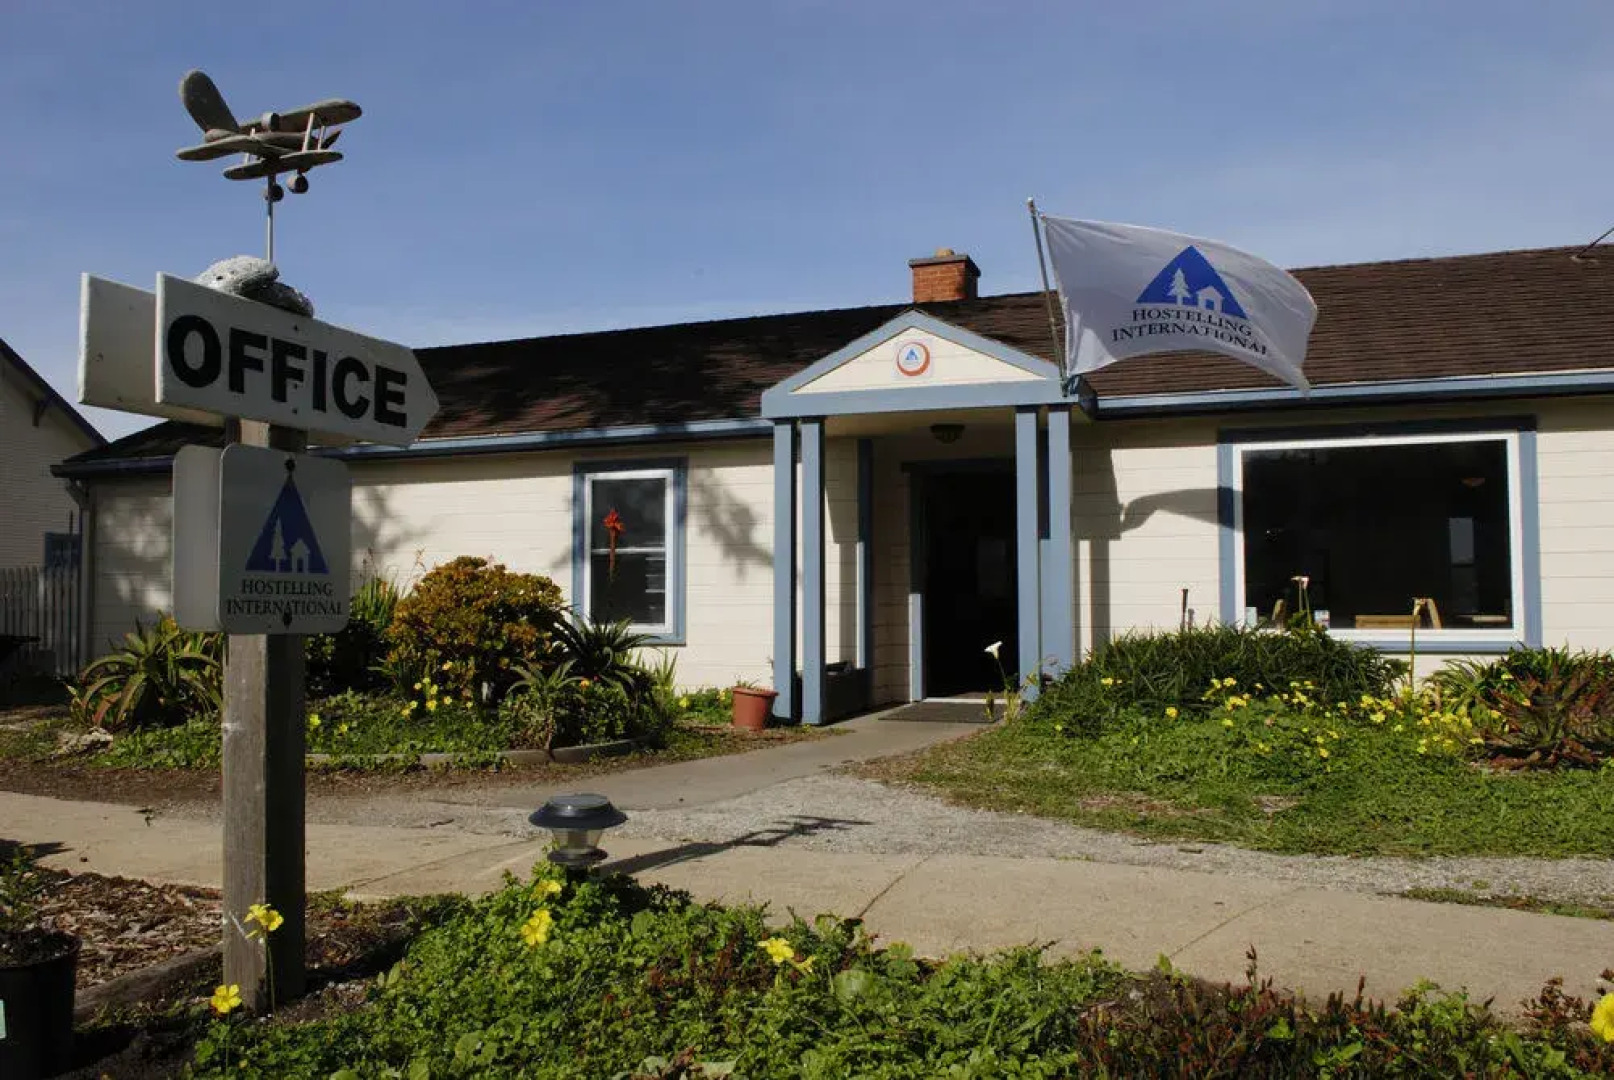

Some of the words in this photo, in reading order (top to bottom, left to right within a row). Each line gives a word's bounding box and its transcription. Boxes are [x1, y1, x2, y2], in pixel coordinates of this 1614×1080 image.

[1131, 307, 1252, 337] HOSTELLING
[1112, 322, 1268, 355] INTERNATIONAL
[167, 314, 408, 428] OFFICE
[240, 578, 335, 597] HOSTELLING
[226, 599, 344, 616] INTERNATIONAL
